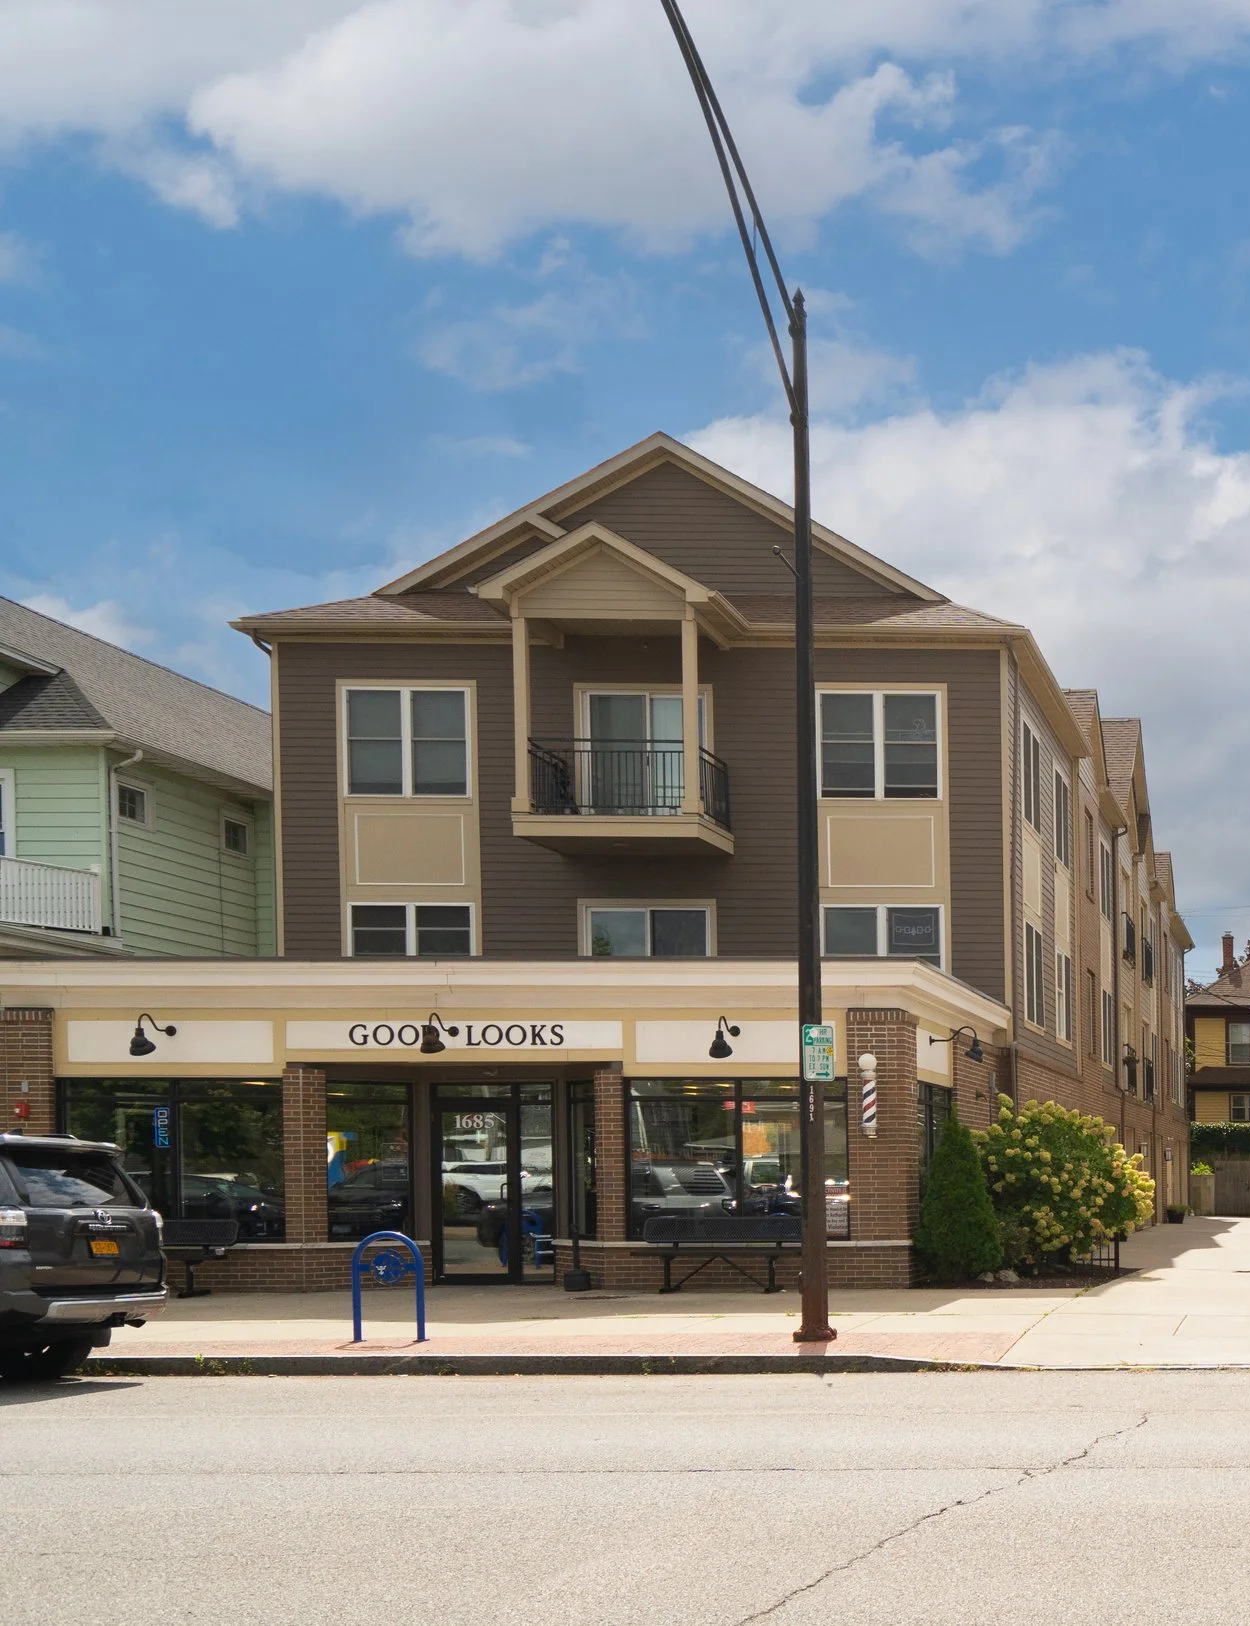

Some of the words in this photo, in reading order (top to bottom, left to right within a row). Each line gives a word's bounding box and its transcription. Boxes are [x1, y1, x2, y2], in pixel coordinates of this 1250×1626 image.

[466, 1024, 565, 1046] LOOKS
[157, 1110, 169, 1146] OPEN
[454, 1114, 495, 1129] 1685
